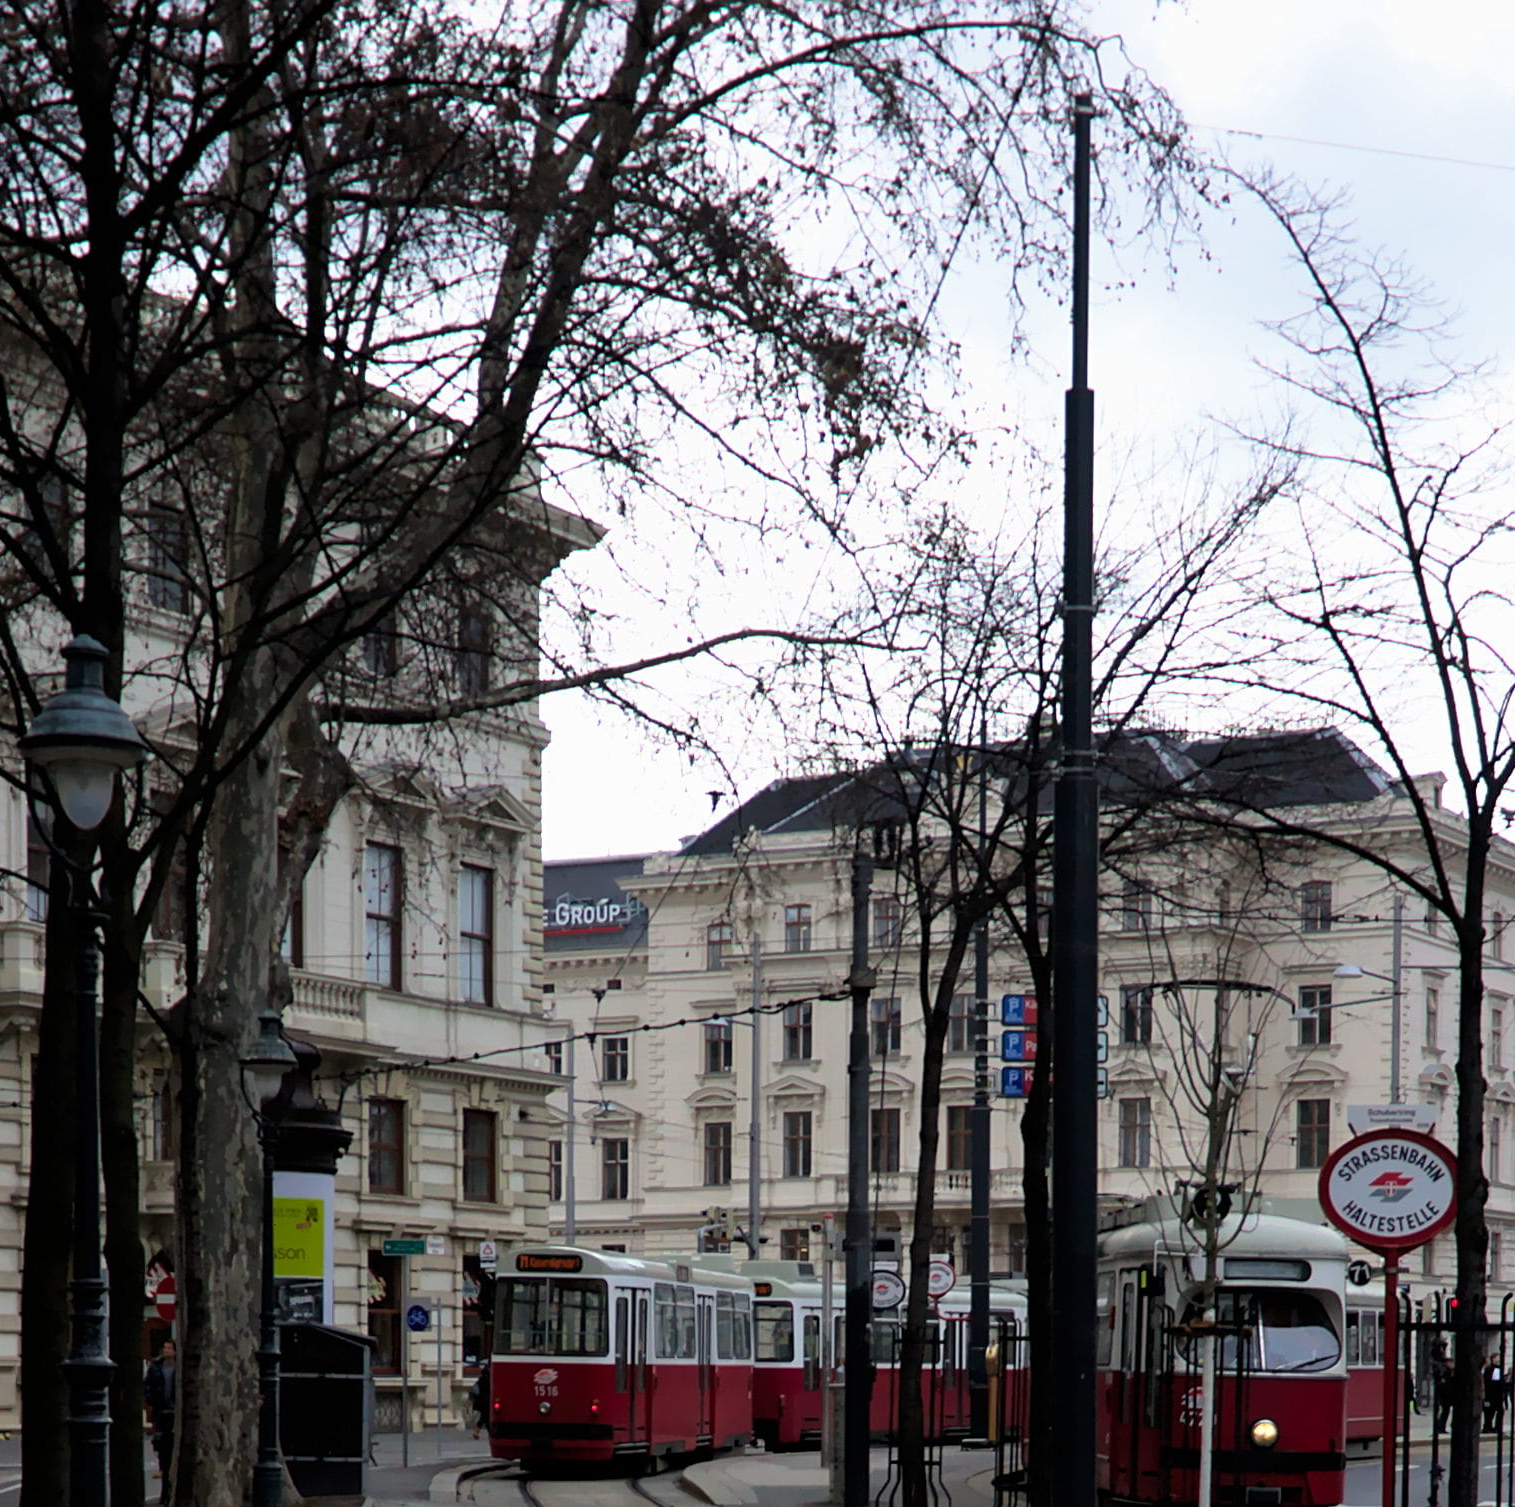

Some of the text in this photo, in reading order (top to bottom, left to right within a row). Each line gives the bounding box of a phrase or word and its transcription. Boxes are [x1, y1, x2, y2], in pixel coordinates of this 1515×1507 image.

[1338, 1144, 1445, 1183] STRASSENBAHN
[1342, 1200, 1440, 1232] HALTESTELLE
[1350, 1263, 1370, 1283] 71
[533, 1385, 559, 1397] 1516
